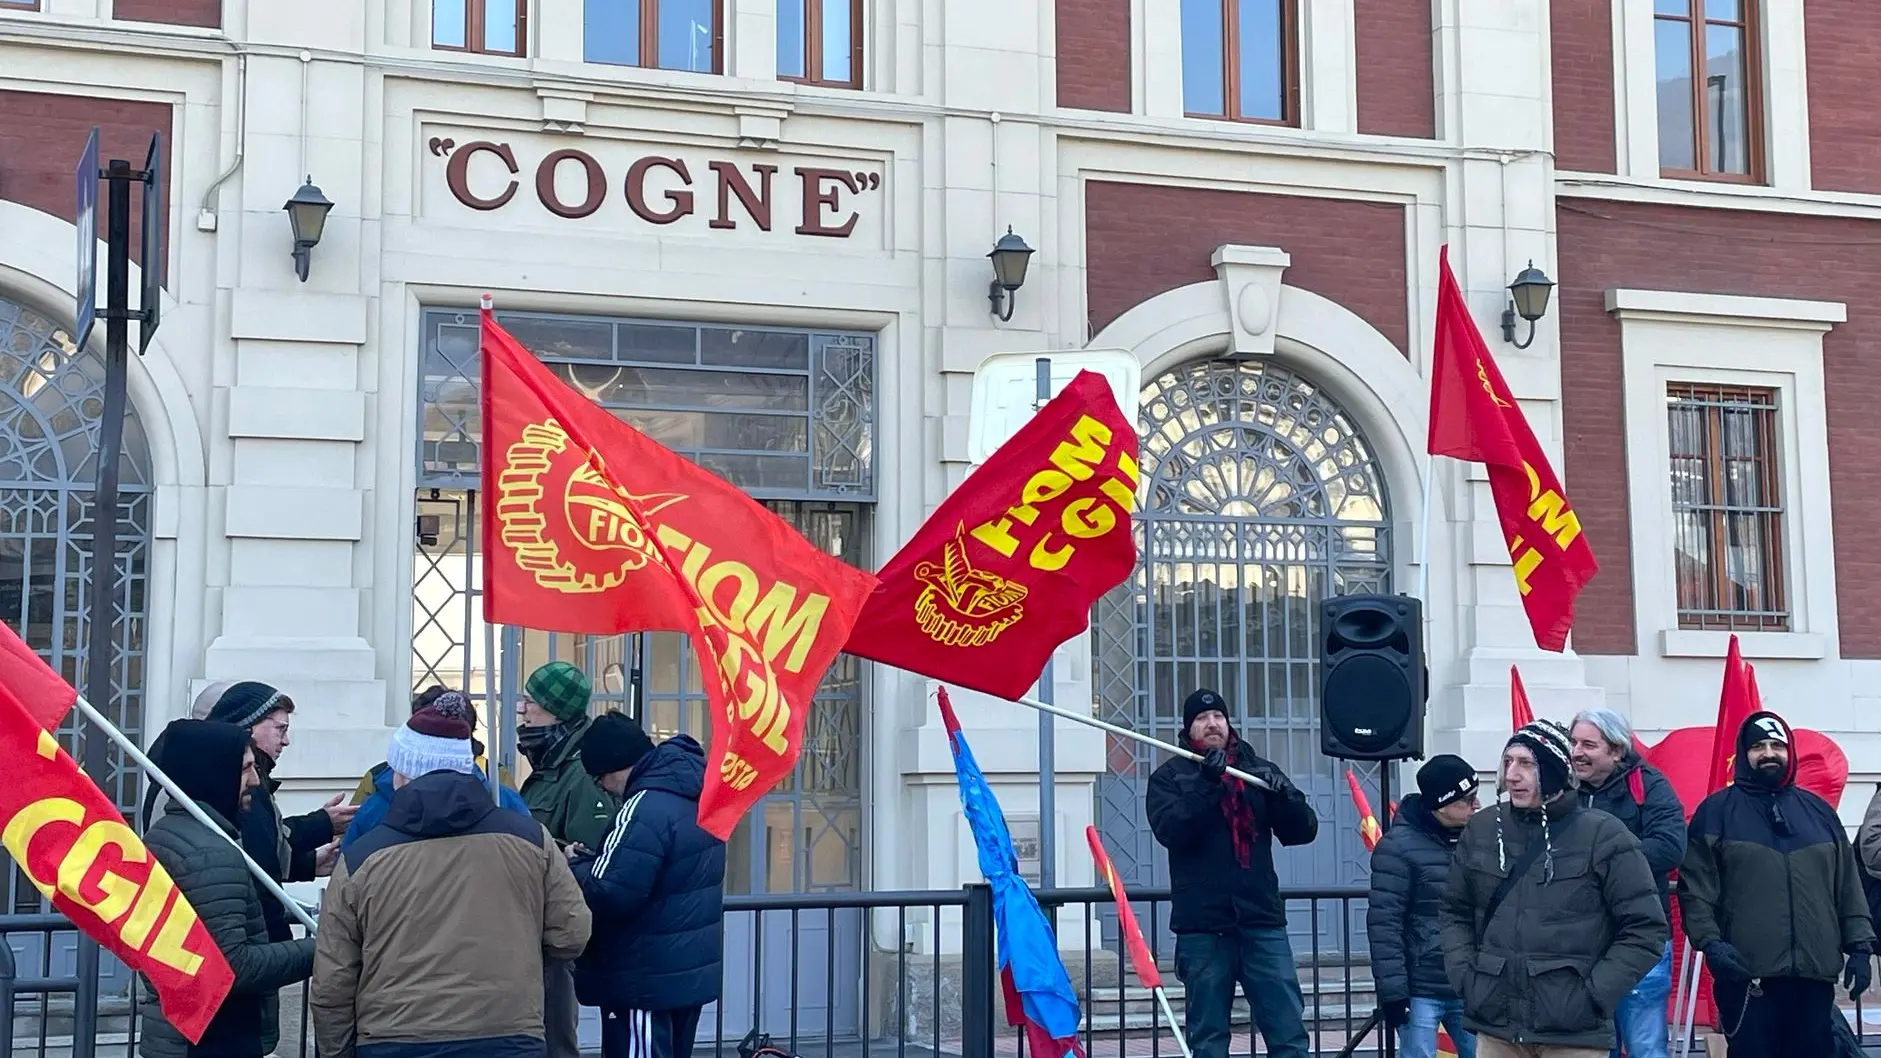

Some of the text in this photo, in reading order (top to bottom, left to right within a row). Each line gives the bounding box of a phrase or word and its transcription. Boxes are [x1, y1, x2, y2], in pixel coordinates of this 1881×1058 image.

[428, 136, 880, 239] “COGNE”
[969, 414, 1113, 558] FIOM
[978, 589, 1024, 610] FIOM
[2, 797, 205, 977] CGIL
